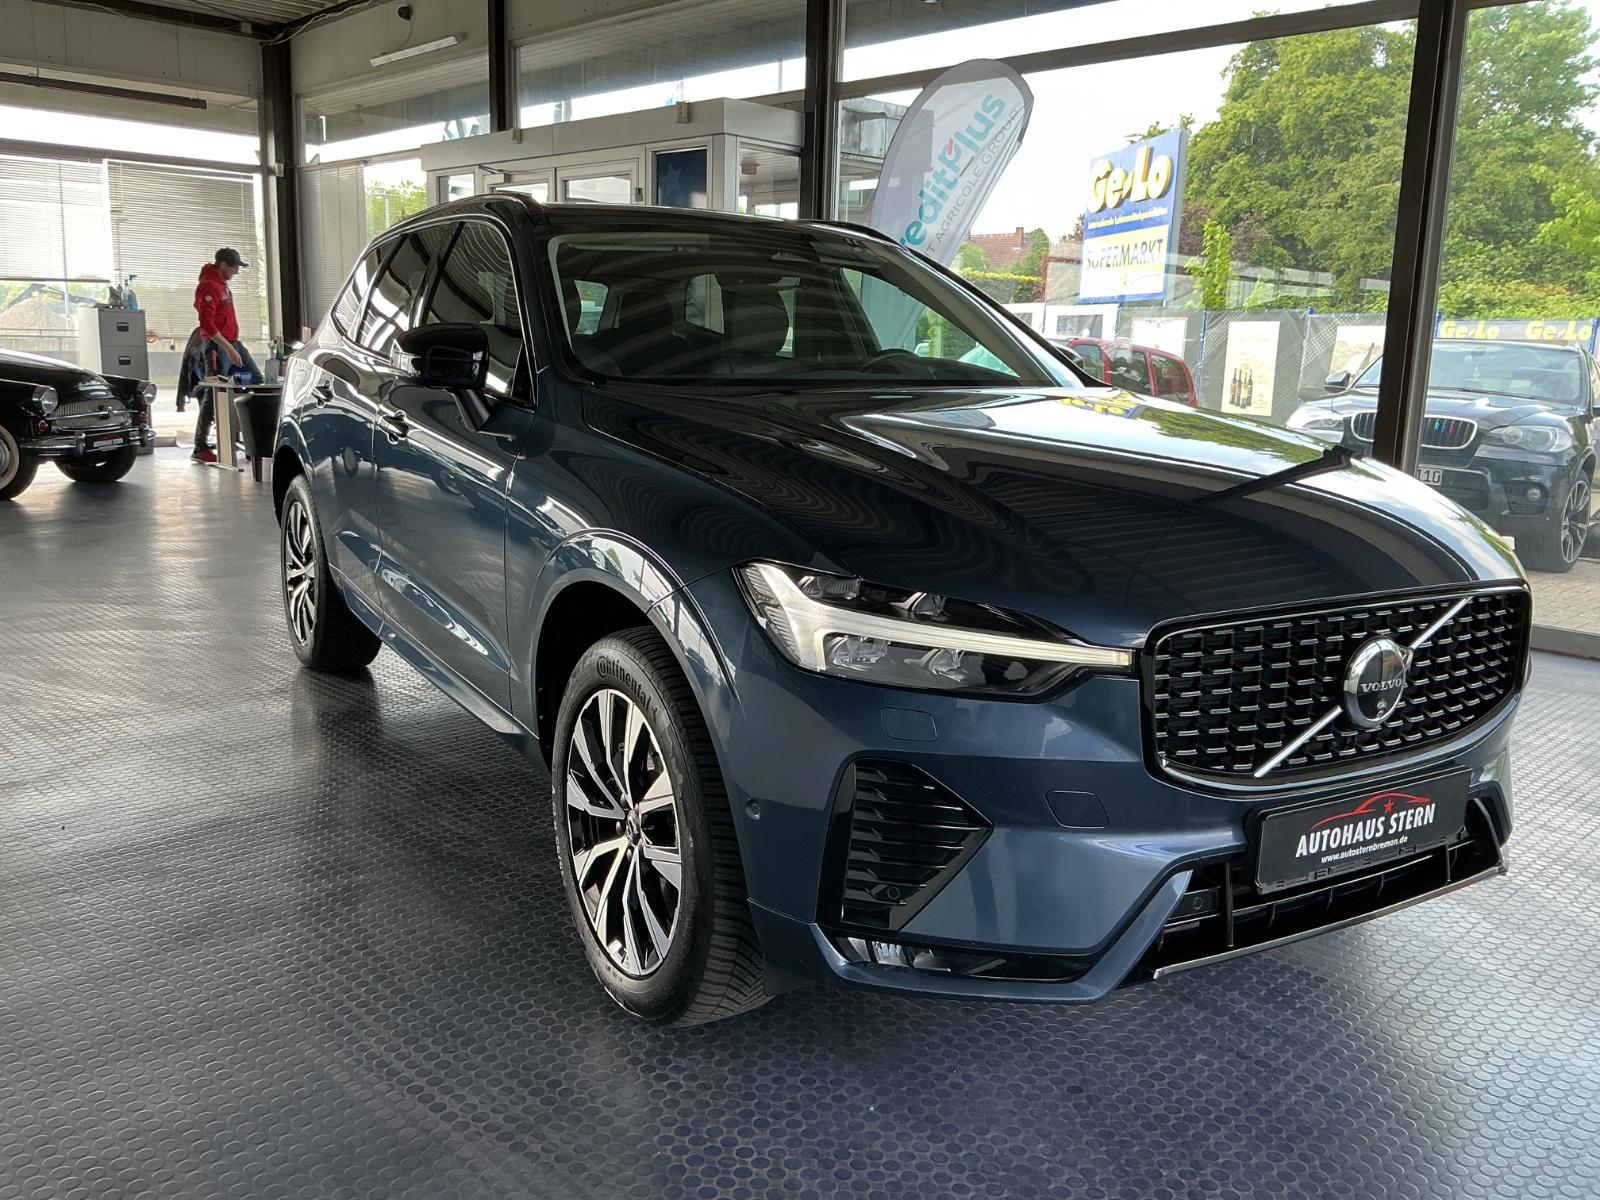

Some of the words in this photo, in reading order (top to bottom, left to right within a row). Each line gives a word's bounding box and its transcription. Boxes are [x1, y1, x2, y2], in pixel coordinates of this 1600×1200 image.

[936, 166, 985, 243] AGRICOLE
[983, 110, 1019, 165] GROUP
[1086, 239, 1163, 270] SUPERMARKT
[597, 655, 651, 712] Continental
[1361, 679, 1402, 693] VOLVO
[1296, 816, 1385, 857] AUTOHAUS
[1389, 803, 1435, 834] STERN
[1321, 835, 1408, 863] www.autosternbremen.de
